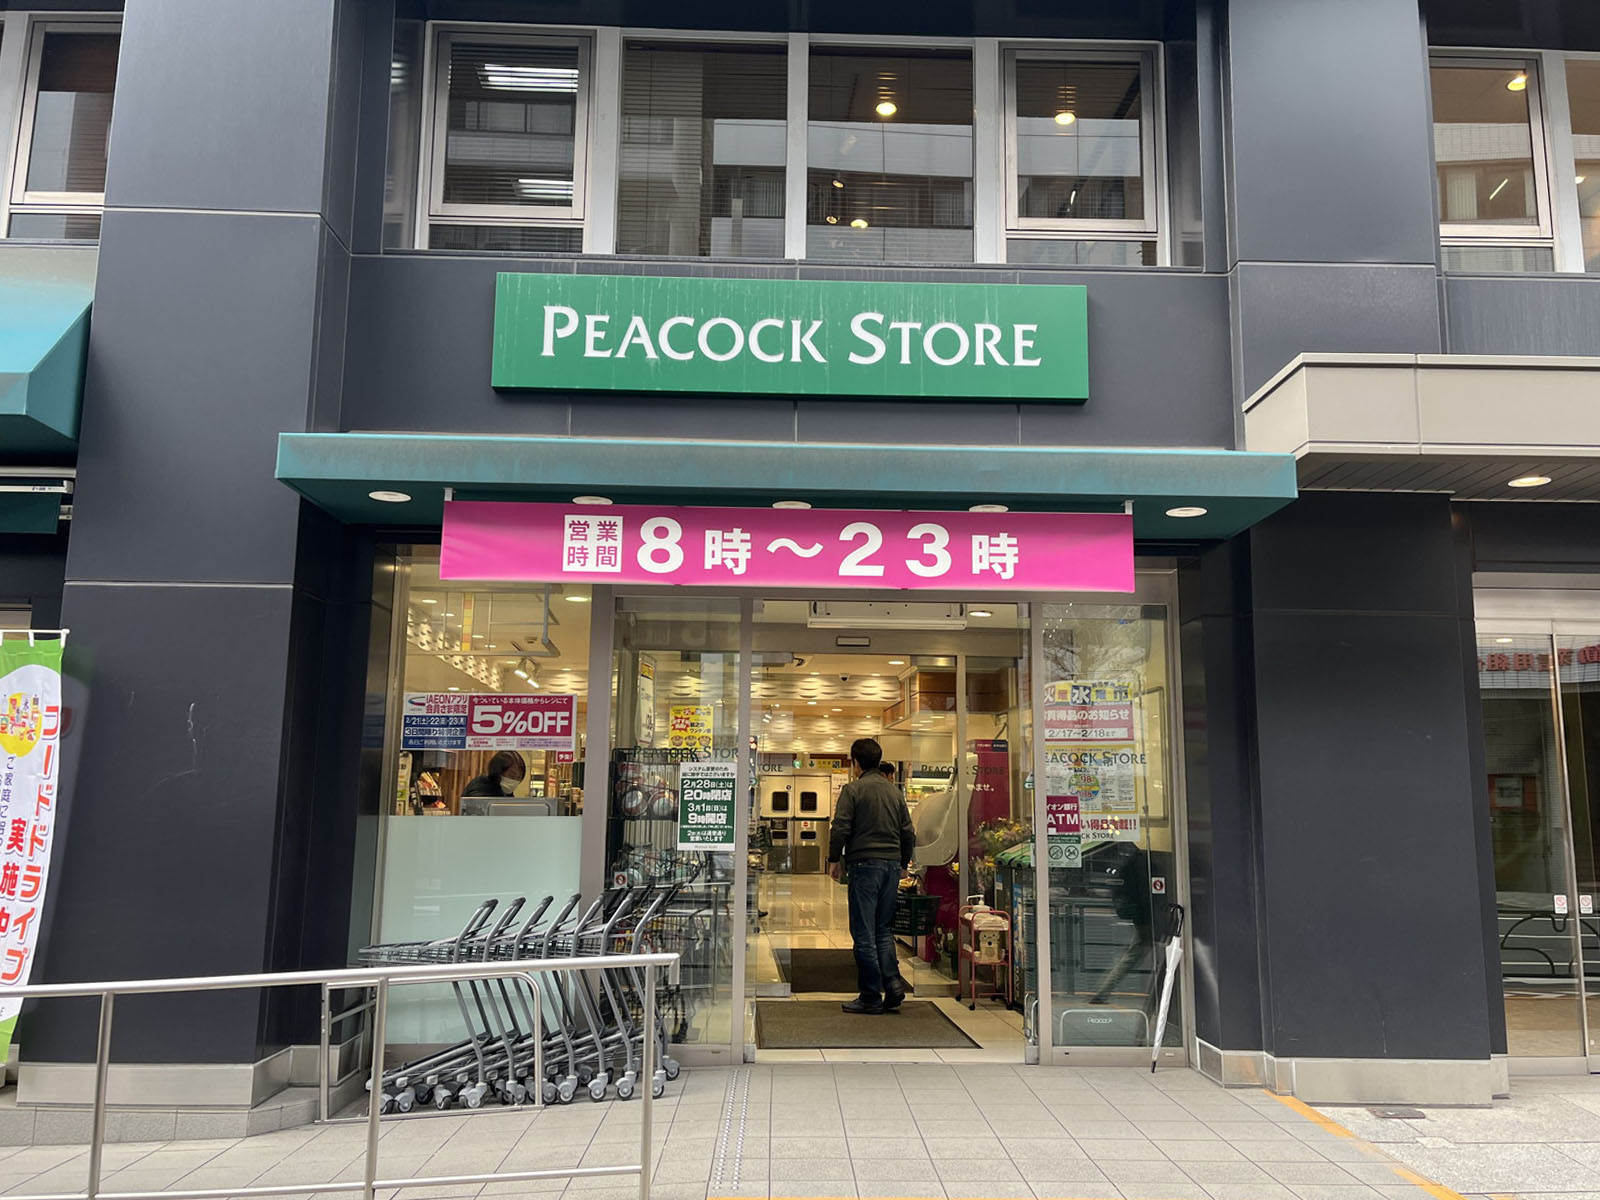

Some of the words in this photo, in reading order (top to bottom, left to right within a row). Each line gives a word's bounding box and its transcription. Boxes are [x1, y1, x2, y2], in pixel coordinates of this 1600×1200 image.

[541, 305, 828, 363] PEACOCK
[848, 312, 1042, 367] STORE
[568, 520, 618, 542] 営業
[567, 545, 618, 568] 時間
[472, 697, 568, 705] 今ついている本体価格からレジにて
[425, 705, 467, 714] 会員さま限定
[1044, 709, 1129, 721] 買得品のお知らせ
[471, 705, 570, 734] 5%OFF
[702, 745, 739, 759] STOR
[1102, 751, 1147, 765] STORE
[1046, 813, 1079, 825] ATM
[2, 706, 59, 981] フードドライブ
